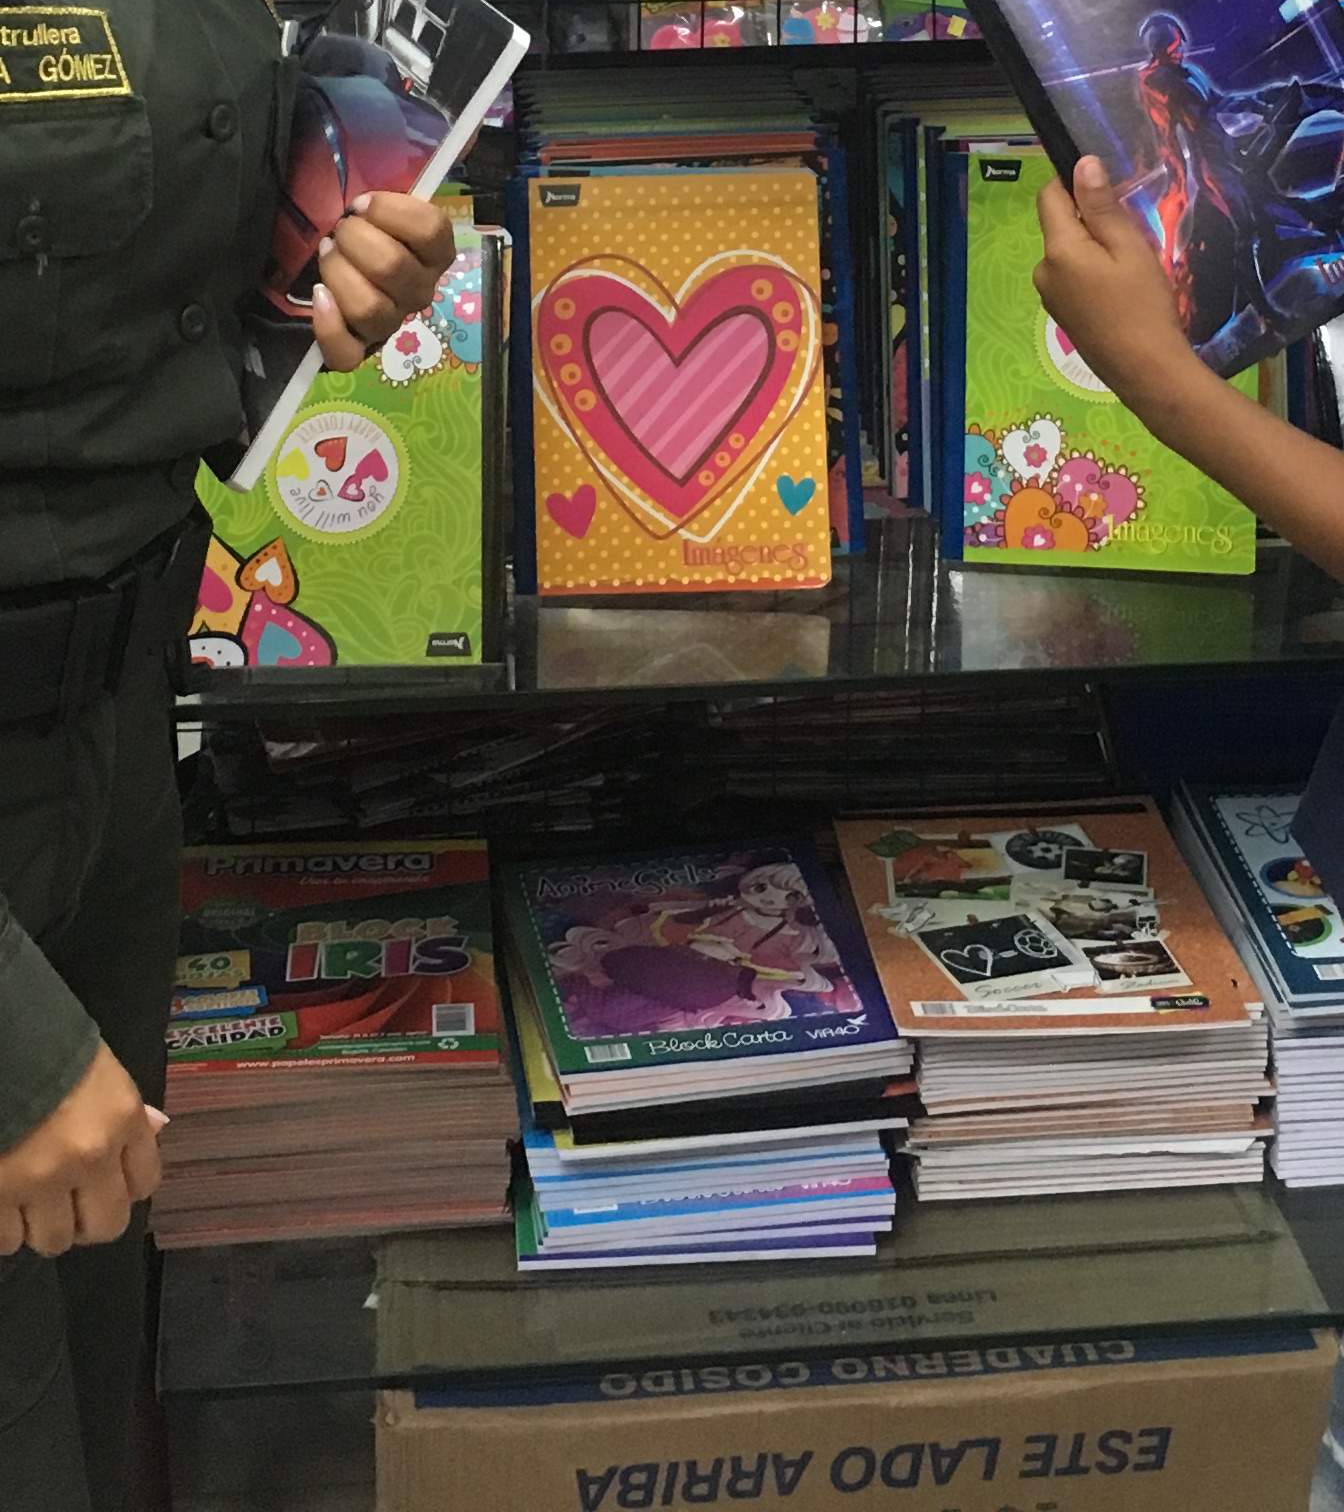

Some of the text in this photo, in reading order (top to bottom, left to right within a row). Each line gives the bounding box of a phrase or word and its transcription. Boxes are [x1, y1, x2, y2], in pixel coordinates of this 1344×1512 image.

[39, 49, 117, 83] GÓMEZ
[985, 165, 1017, 178] Norma
[544, 191, 577, 203] Norma
[289, 485, 385, 529] you will live
[1106, 514, 1233, 554] Imágenes
[681, 535, 809, 576] Imágenes
[431, 636, 465, 650] Norma
[206, 852, 434, 877] Primavera
[296, 915, 459, 944] BLOCK
[285, 935, 473, 982] IRIS
[974, 981, 1043, 998] Soccer
[166, 1025, 287, 1051] CALIDAD
[598, 1339, 1136, 1397] CUADERNO COSIDO
[575, 1426, 1172, 1511] ESTE LADO ARRIBA
